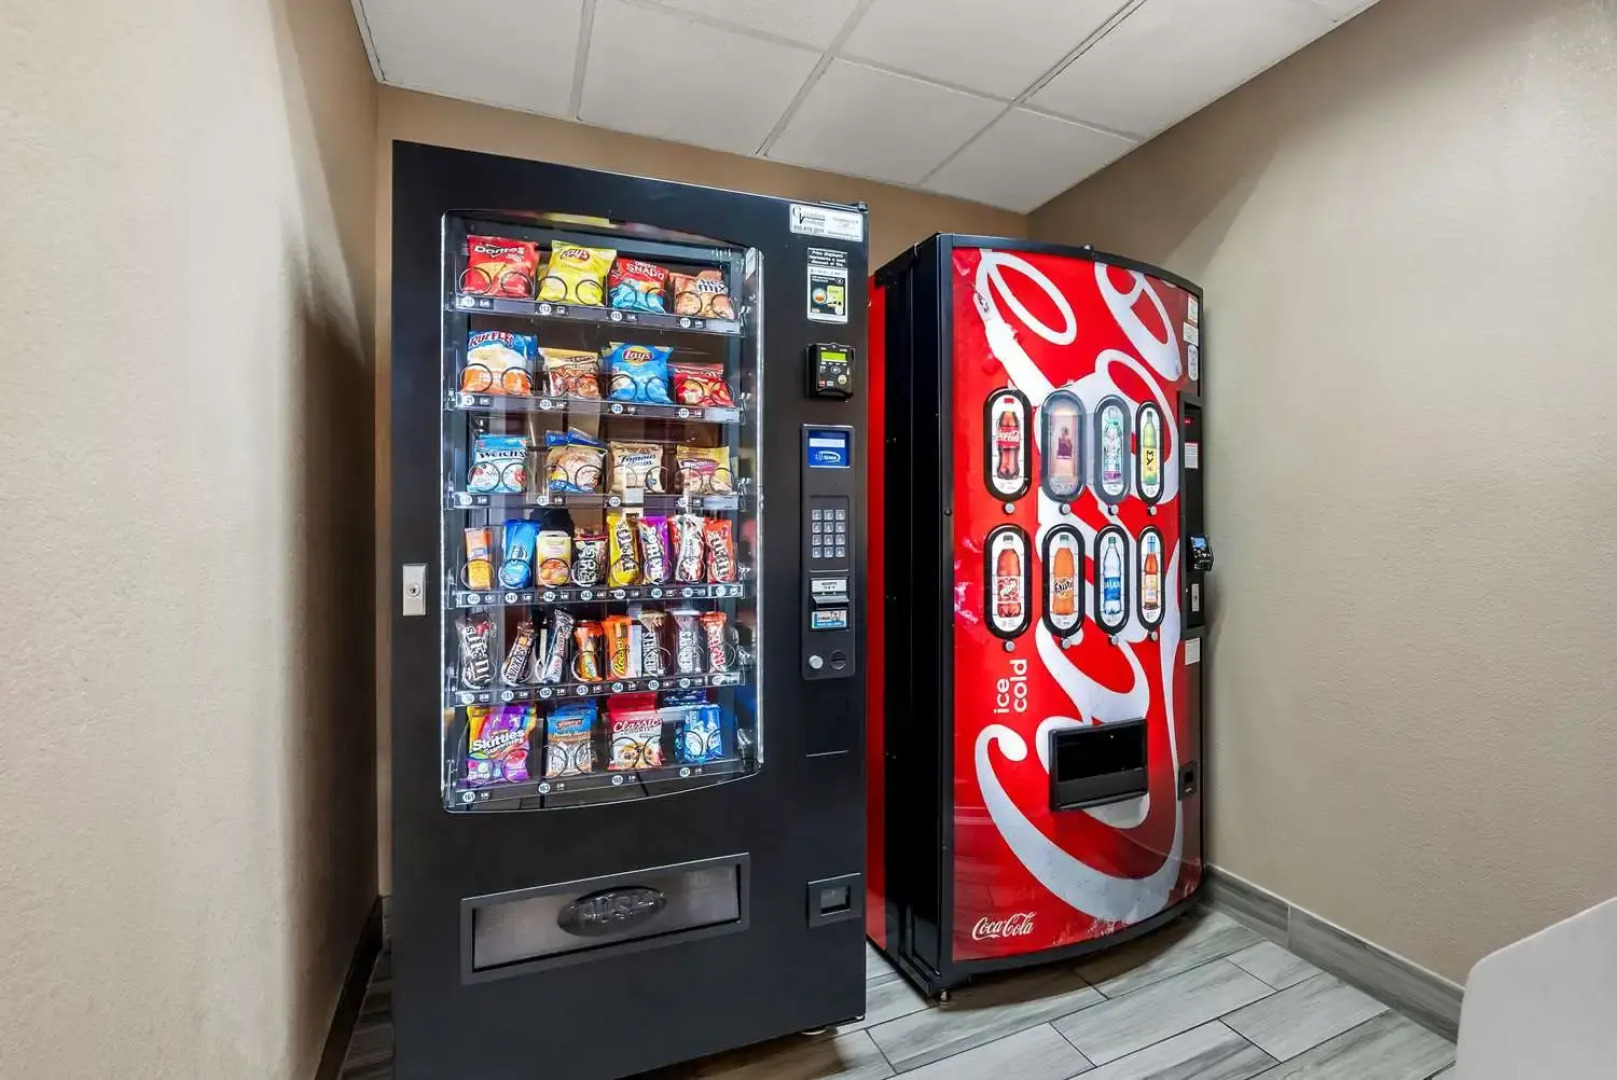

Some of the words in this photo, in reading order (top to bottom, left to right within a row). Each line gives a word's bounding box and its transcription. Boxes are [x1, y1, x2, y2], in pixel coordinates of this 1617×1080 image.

[474, 245, 525, 257] Doritos
[619, 453, 657, 465] Famous
[506, 647, 527, 682] SNICKERS
[994, 678, 1010, 714] ice
[1010, 659, 1028, 713] cold
[613, 718, 661, 732] Classic
[472, 729, 525, 751] Skittles
[971, 911, 1037, 941] Coca-Cola
